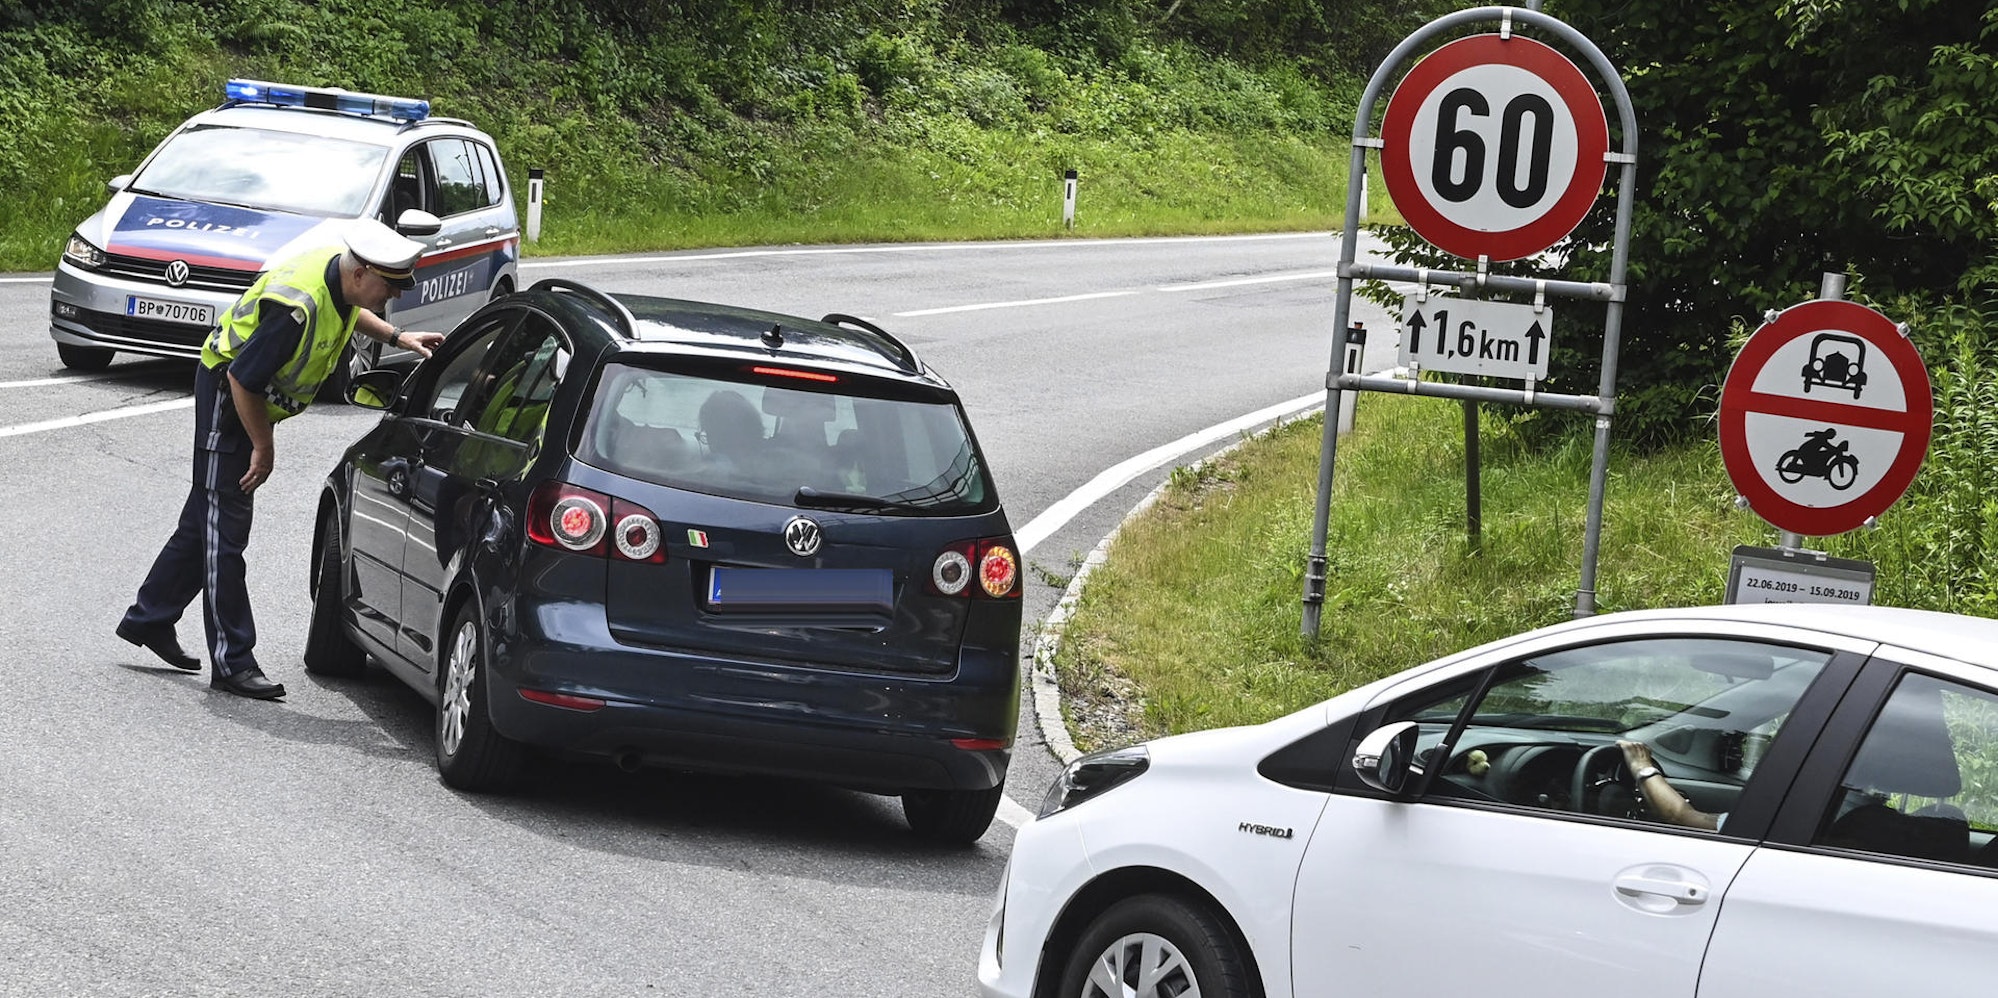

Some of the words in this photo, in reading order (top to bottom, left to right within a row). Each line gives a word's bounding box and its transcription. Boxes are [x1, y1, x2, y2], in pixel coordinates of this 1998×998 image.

[1431, 87, 1554, 209] 60
[146, 217, 261, 239] POLIZEI
[420, 270, 468, 304] POLIZEI
[139, 301, 155, 315] BP
[165, 304, 207, 322] 70706
[1433, 310, 1476, 359] 1,6
[1479, 330, 1519, 361] km
[1747, 578, 1798, 593] 22.06.2019
[1810, 586, 1860, 601] 15.09.2019
[1238, 822, 1285, 839] HYBRID
